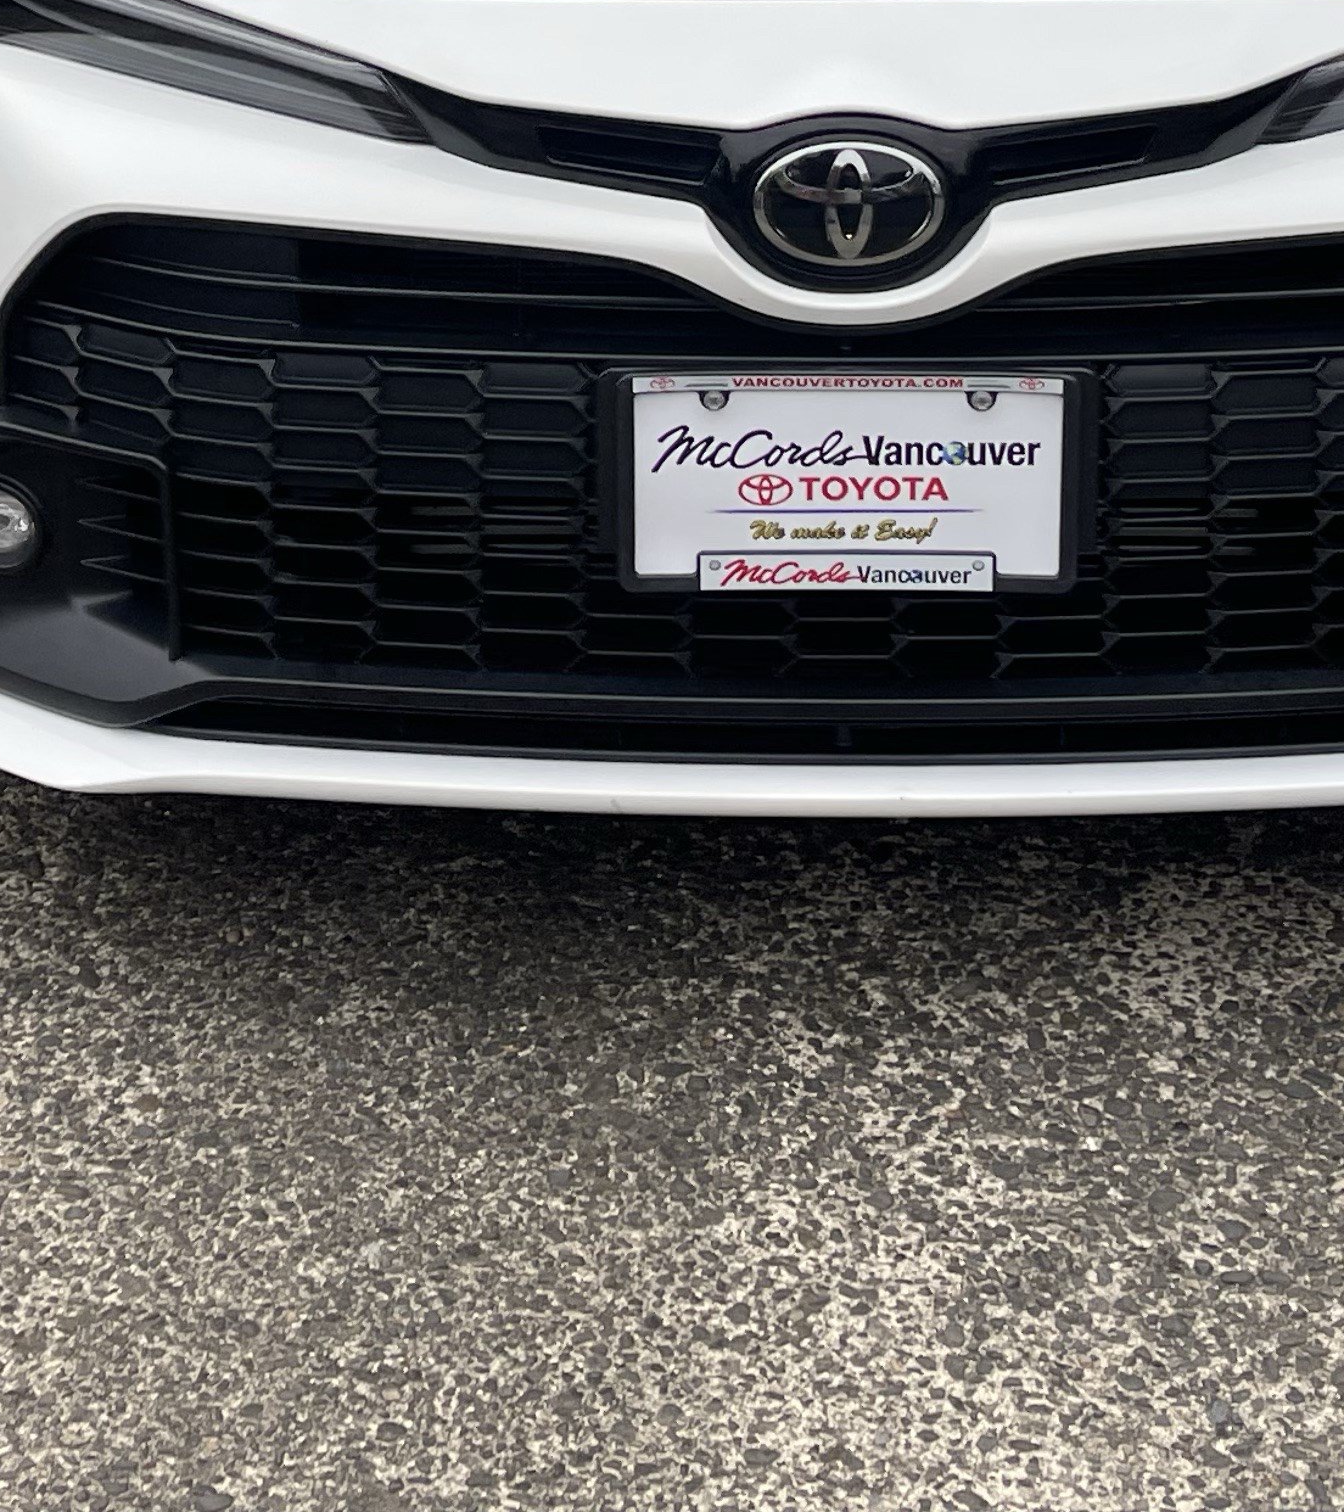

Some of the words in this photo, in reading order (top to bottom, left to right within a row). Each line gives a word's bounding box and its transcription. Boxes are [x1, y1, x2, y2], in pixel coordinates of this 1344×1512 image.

[732, 377, 964, 389] VANCOUVERTOYOTA.COM
[799, 476, 949, 501] TOYOTA
[750, 518, 786, 540] We
[790, 520, 846, 540] make
[850, 524, 870, 540] it
[874, 516, 938, 545] Easy!
